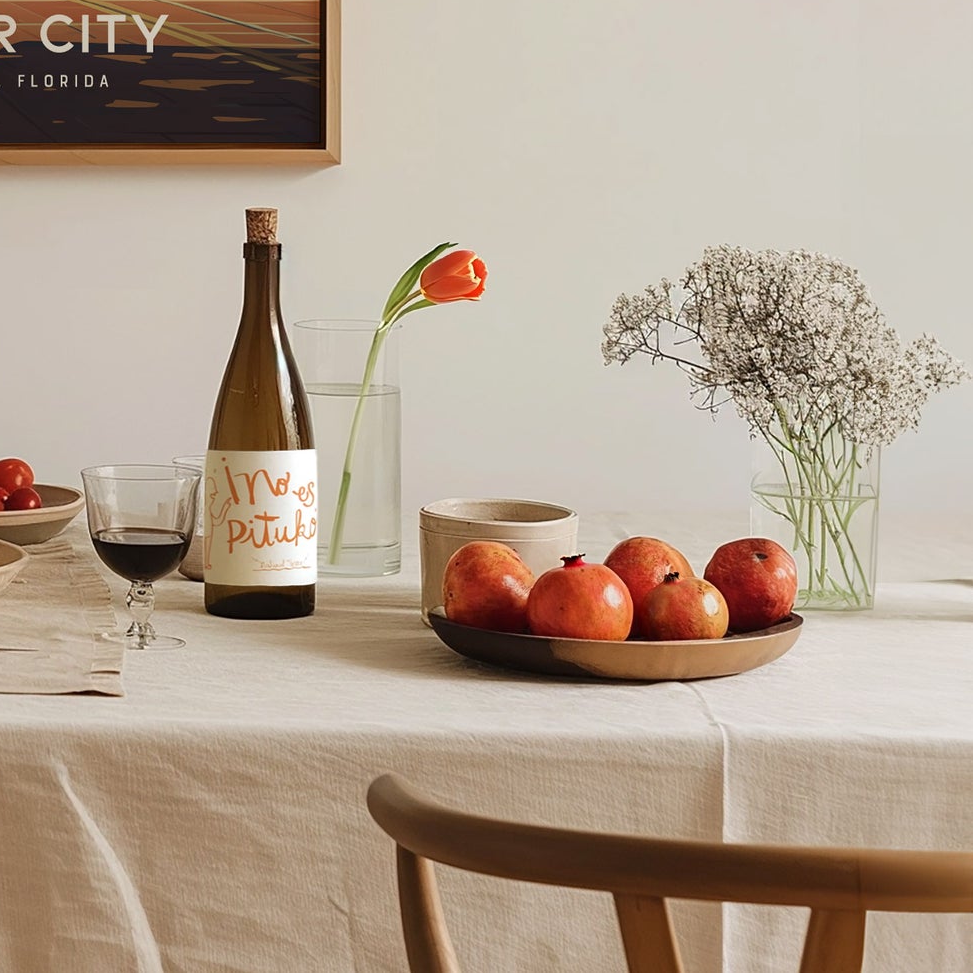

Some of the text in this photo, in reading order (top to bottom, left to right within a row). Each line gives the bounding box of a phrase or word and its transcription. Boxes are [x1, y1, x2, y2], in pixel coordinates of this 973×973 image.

[39, 13, 169, 54] CITY
[18, 74, 110, 88] FLORIDA
[292, 481, 315, 507] es
